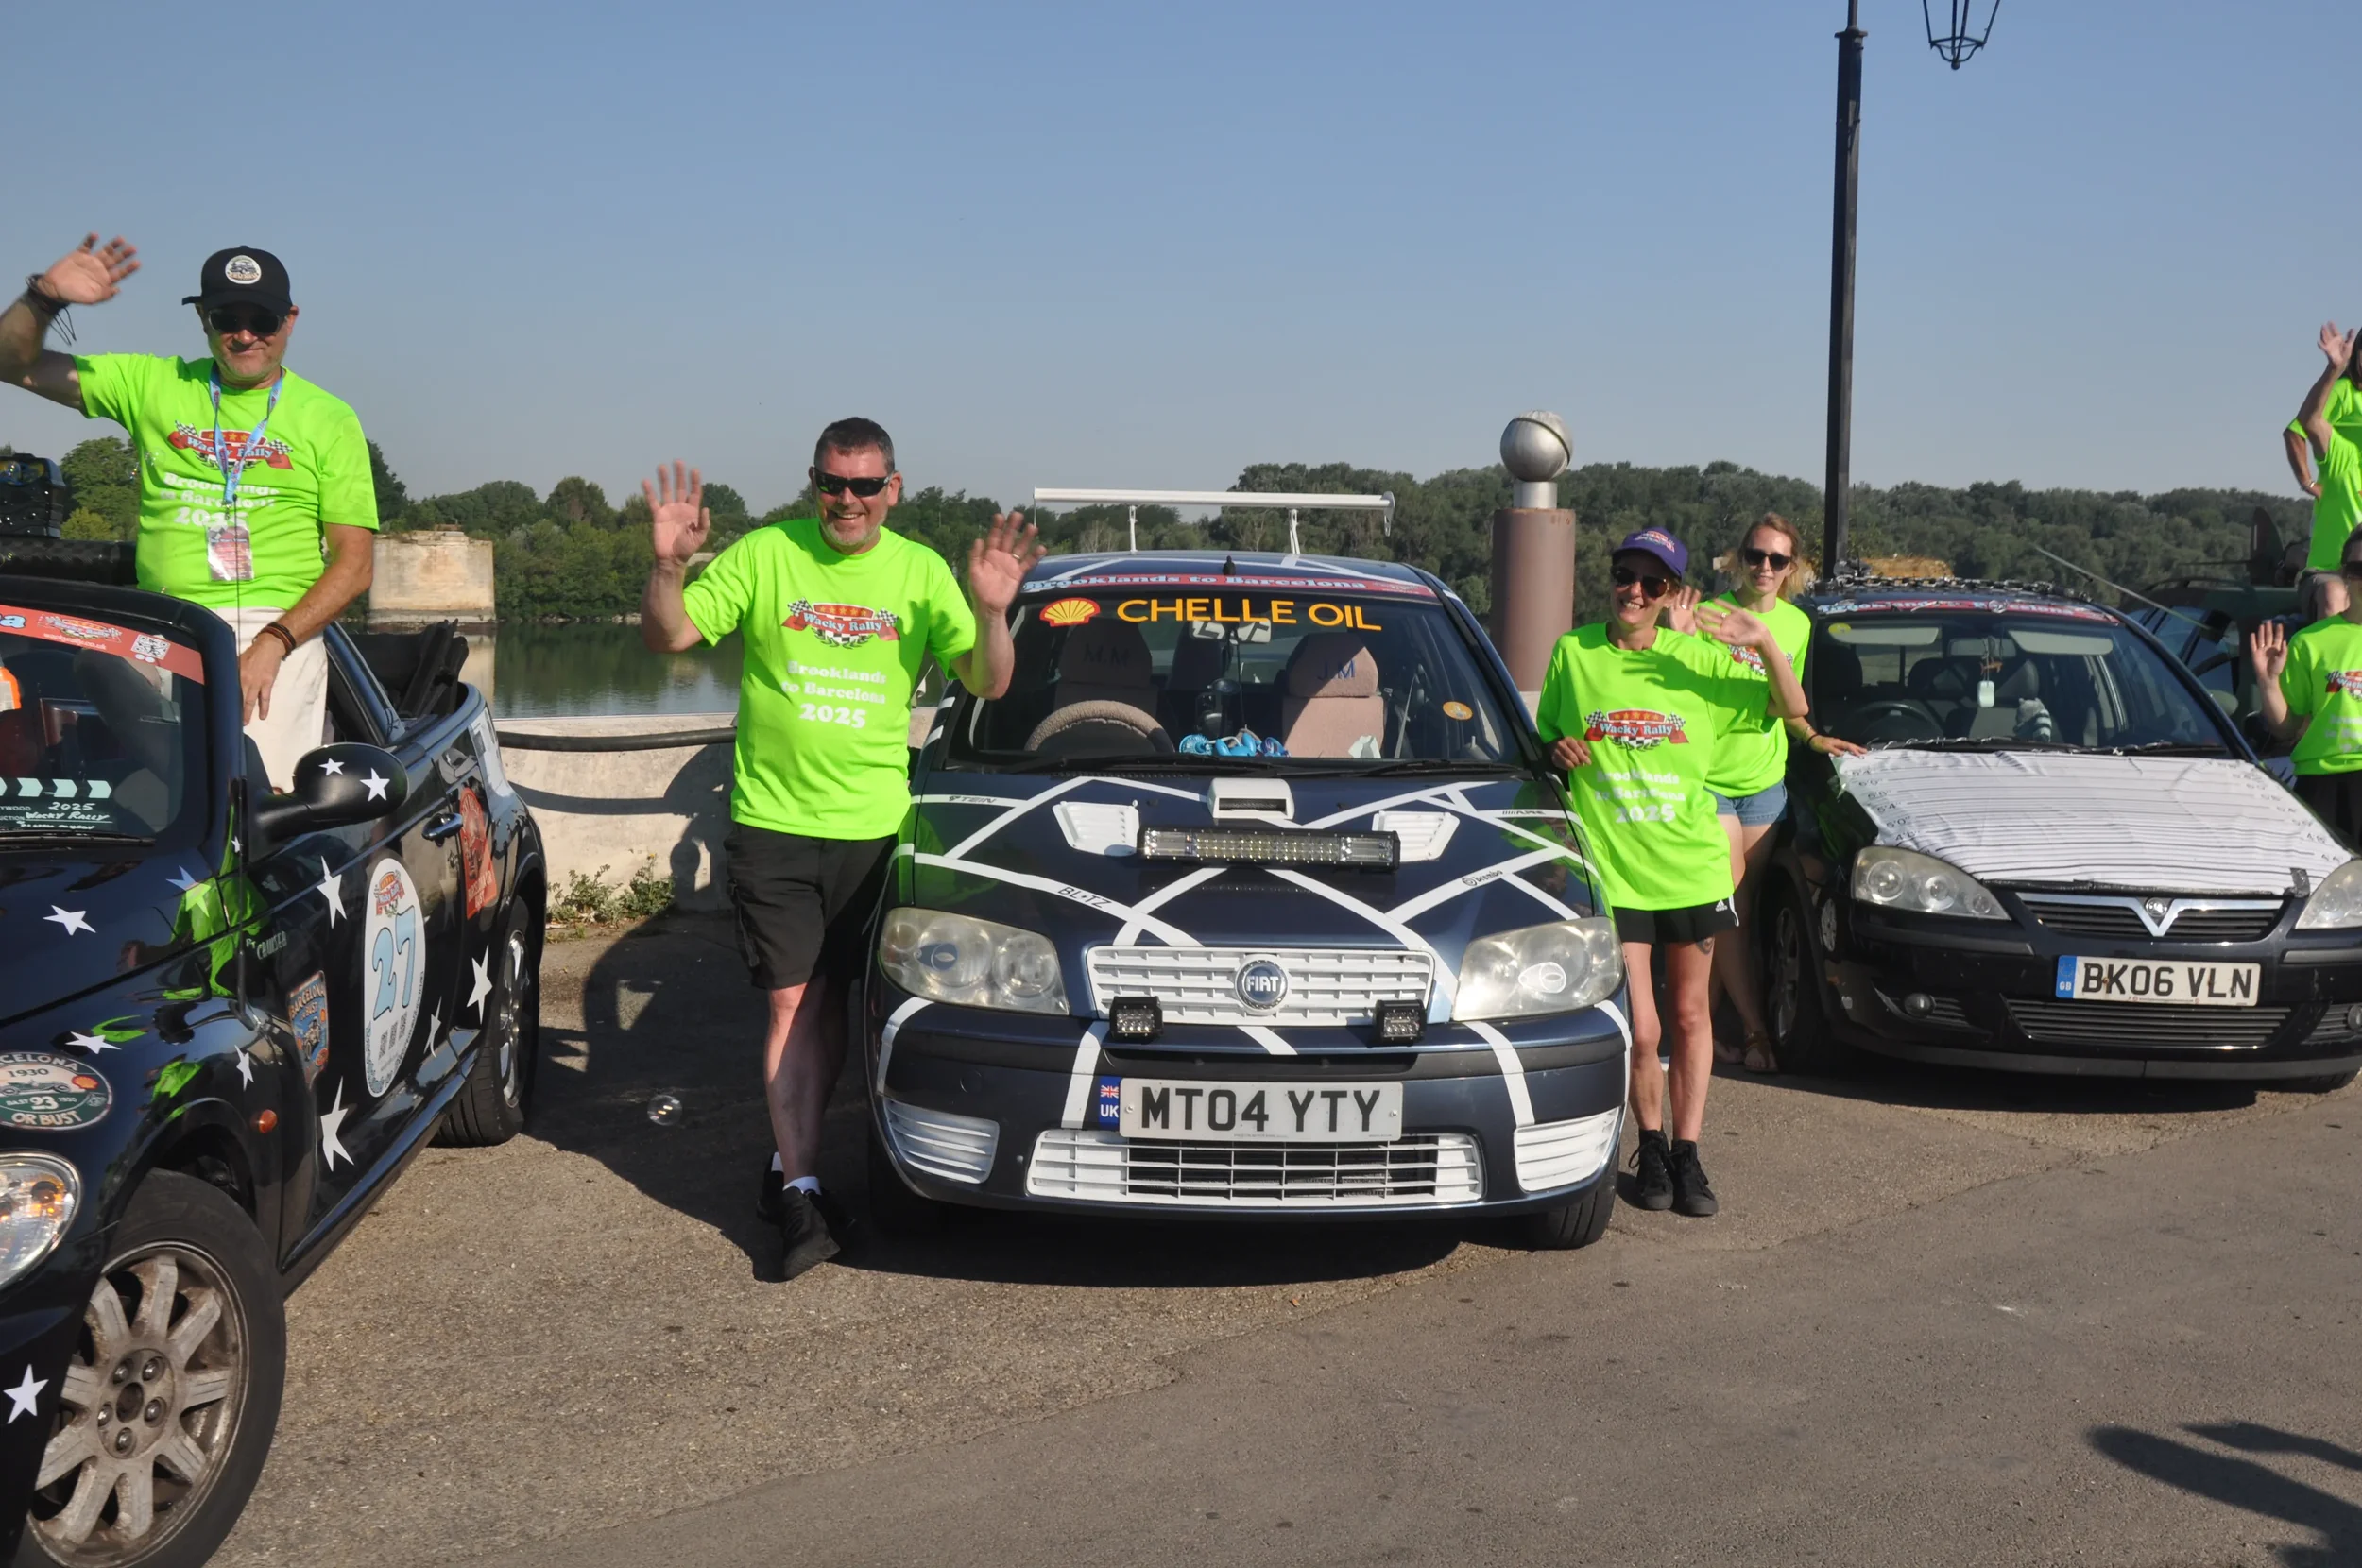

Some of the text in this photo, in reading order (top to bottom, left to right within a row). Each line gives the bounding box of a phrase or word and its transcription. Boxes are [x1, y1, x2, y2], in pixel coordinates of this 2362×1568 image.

[187, 435, 233, 459] Wacy
[1022, 575, 1180, 592] Brooklands
[1225, 575, 1367, 589] Barcelona
[803, 612, 883, 632] Wacky Rally
[1117, 598, 1382, 632] CHELLE OIL
[787, 660, 887, 685] Brooklands
[780, 680, 886, 705] to Barcelona
[798, 702, 867, 729] 2025
[1600, 723, 1673, 736] Wacky Rally
[48, 802, 95, 810] 2025
[1615, 803, 1675, 824] 2025
[1475, 869, 1504, 883] brembo
[372, 904, 416, 1022] 27
[1246, 975, 1279, 993] FIAT
[2059, 980, 2072, 991] GB
[2081, 963, 2252, 999] BK06 VLN
[8, 1067, 49, 1078] 1930
[29, 1096, 59, 1110] 93
[1100, 1086, 1380, 1133] UK MT04 YTY
[11, 1110, 82, 1126] OR BUST
